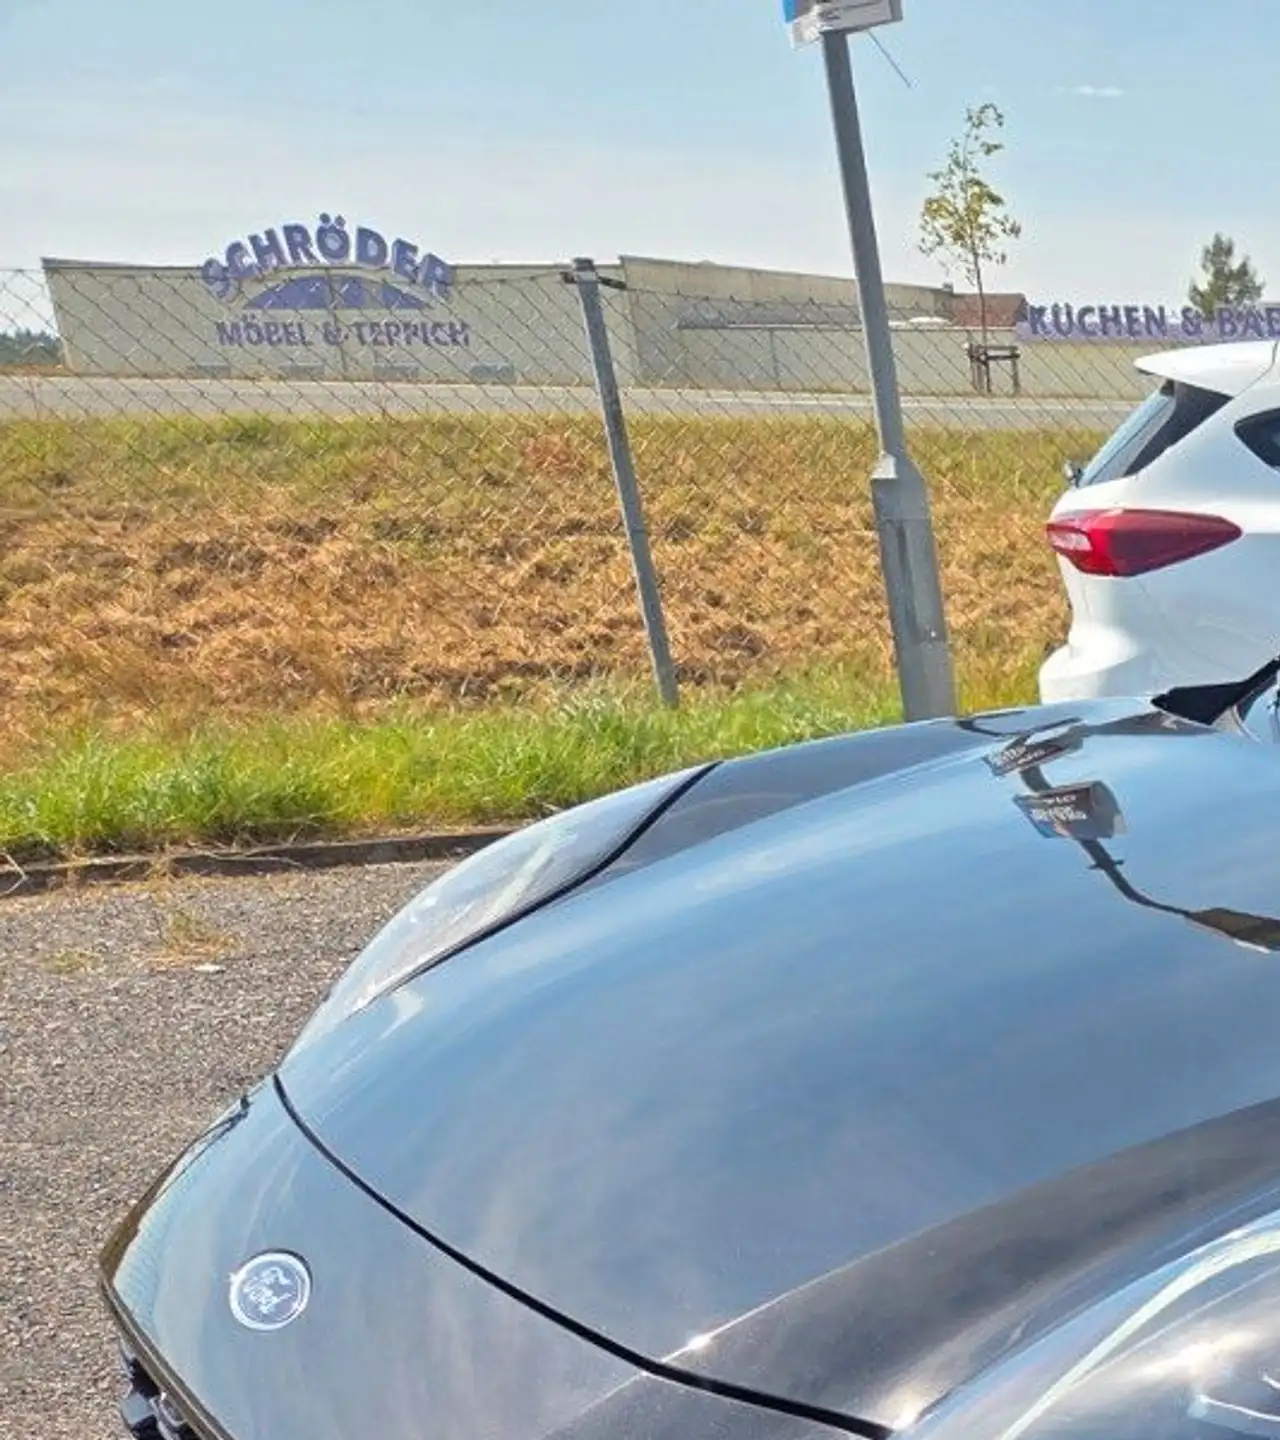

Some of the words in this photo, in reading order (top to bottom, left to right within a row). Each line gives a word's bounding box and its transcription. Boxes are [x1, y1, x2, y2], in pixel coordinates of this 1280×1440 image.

[201, 212, 455, 299] SCHRÖDER
[216, 313, 313, 347] MÖBEL
[322, 321, 349, 347] &
[350, 320, 471, 347] TEPPICH
[1029, 302, 1167, 338] KÜCHEN
[1180, 305, 1201, 337] &
